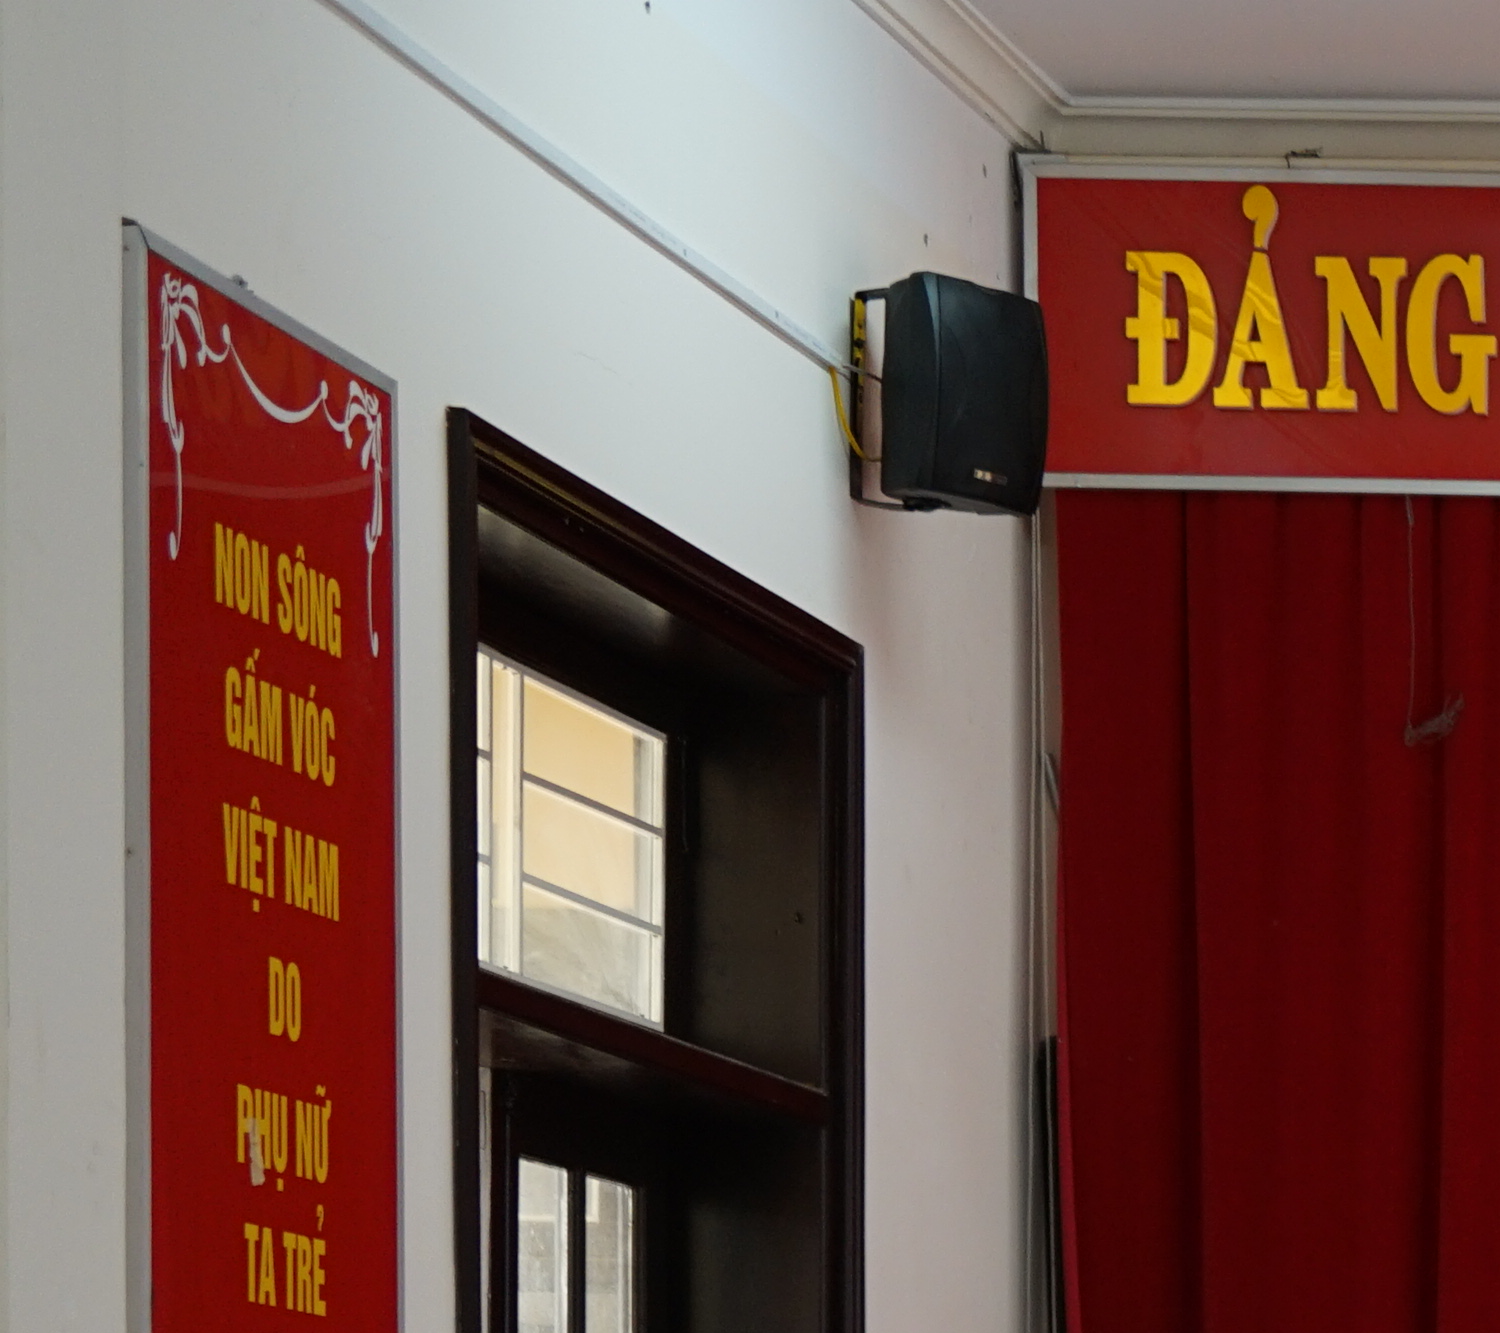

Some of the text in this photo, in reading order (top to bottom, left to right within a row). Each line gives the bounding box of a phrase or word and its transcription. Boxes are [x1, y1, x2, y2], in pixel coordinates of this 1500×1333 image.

[1125, 186, 1497, 415] ĐẢNG
[214, 522, 342, 659] NON SÔNG
[225, 648, 336, 787] GẤM VÓC
[222, 795, 340, 922] VIỆT NAM
[269, 956, 301, 1042] DO
[237, 1083, 333, 1192] PHỤ NỮ
[244, 1204, 327, 1317] TA TRẺ
